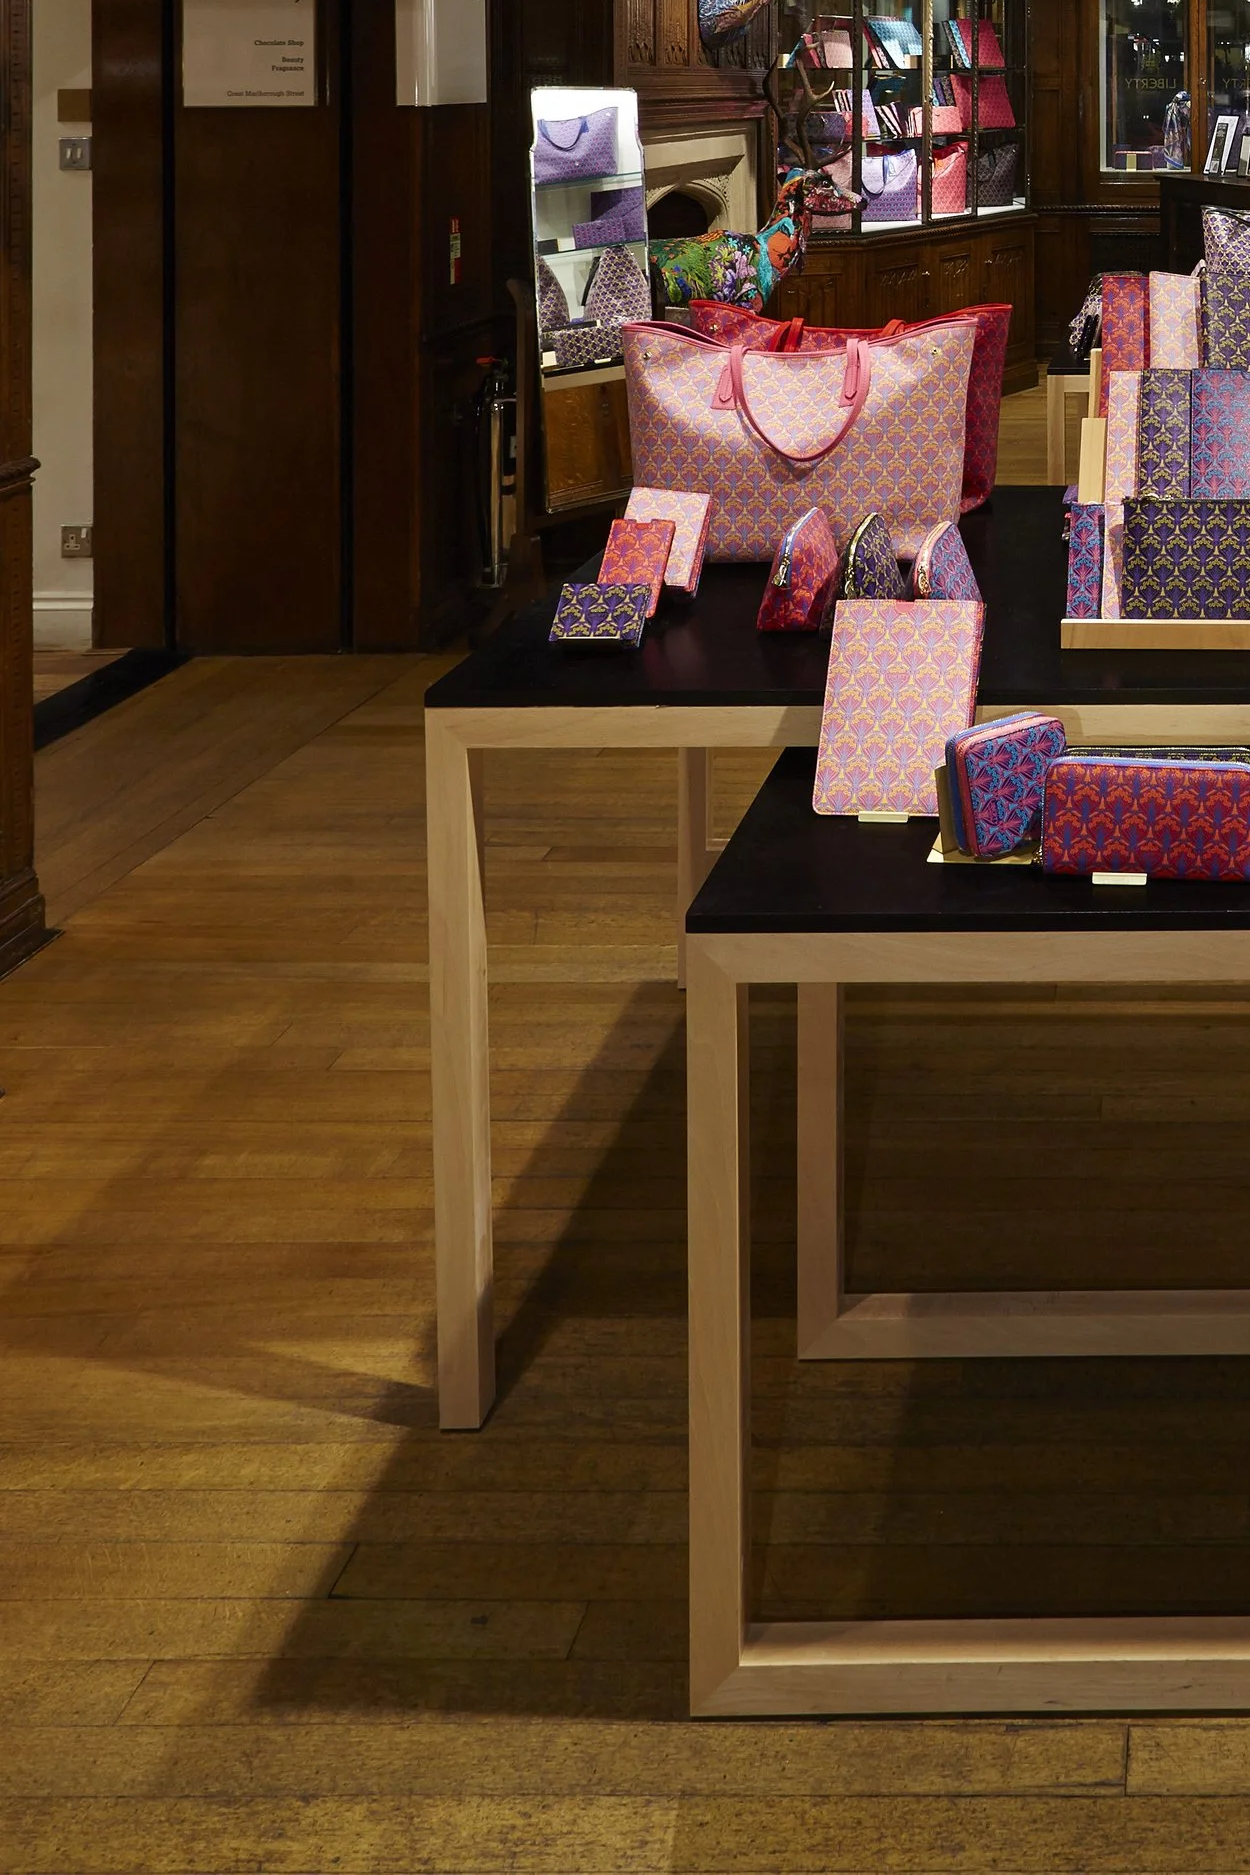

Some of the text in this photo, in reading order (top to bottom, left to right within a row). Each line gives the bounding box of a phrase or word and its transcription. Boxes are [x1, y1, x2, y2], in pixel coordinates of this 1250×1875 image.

[254, 39, 304, 48] Chocolate Shop
[281, 56, 304, 64] Beauty
[271, 65, 304, 73] Fragrance
[245, 90, 285, 98] Marlborough
